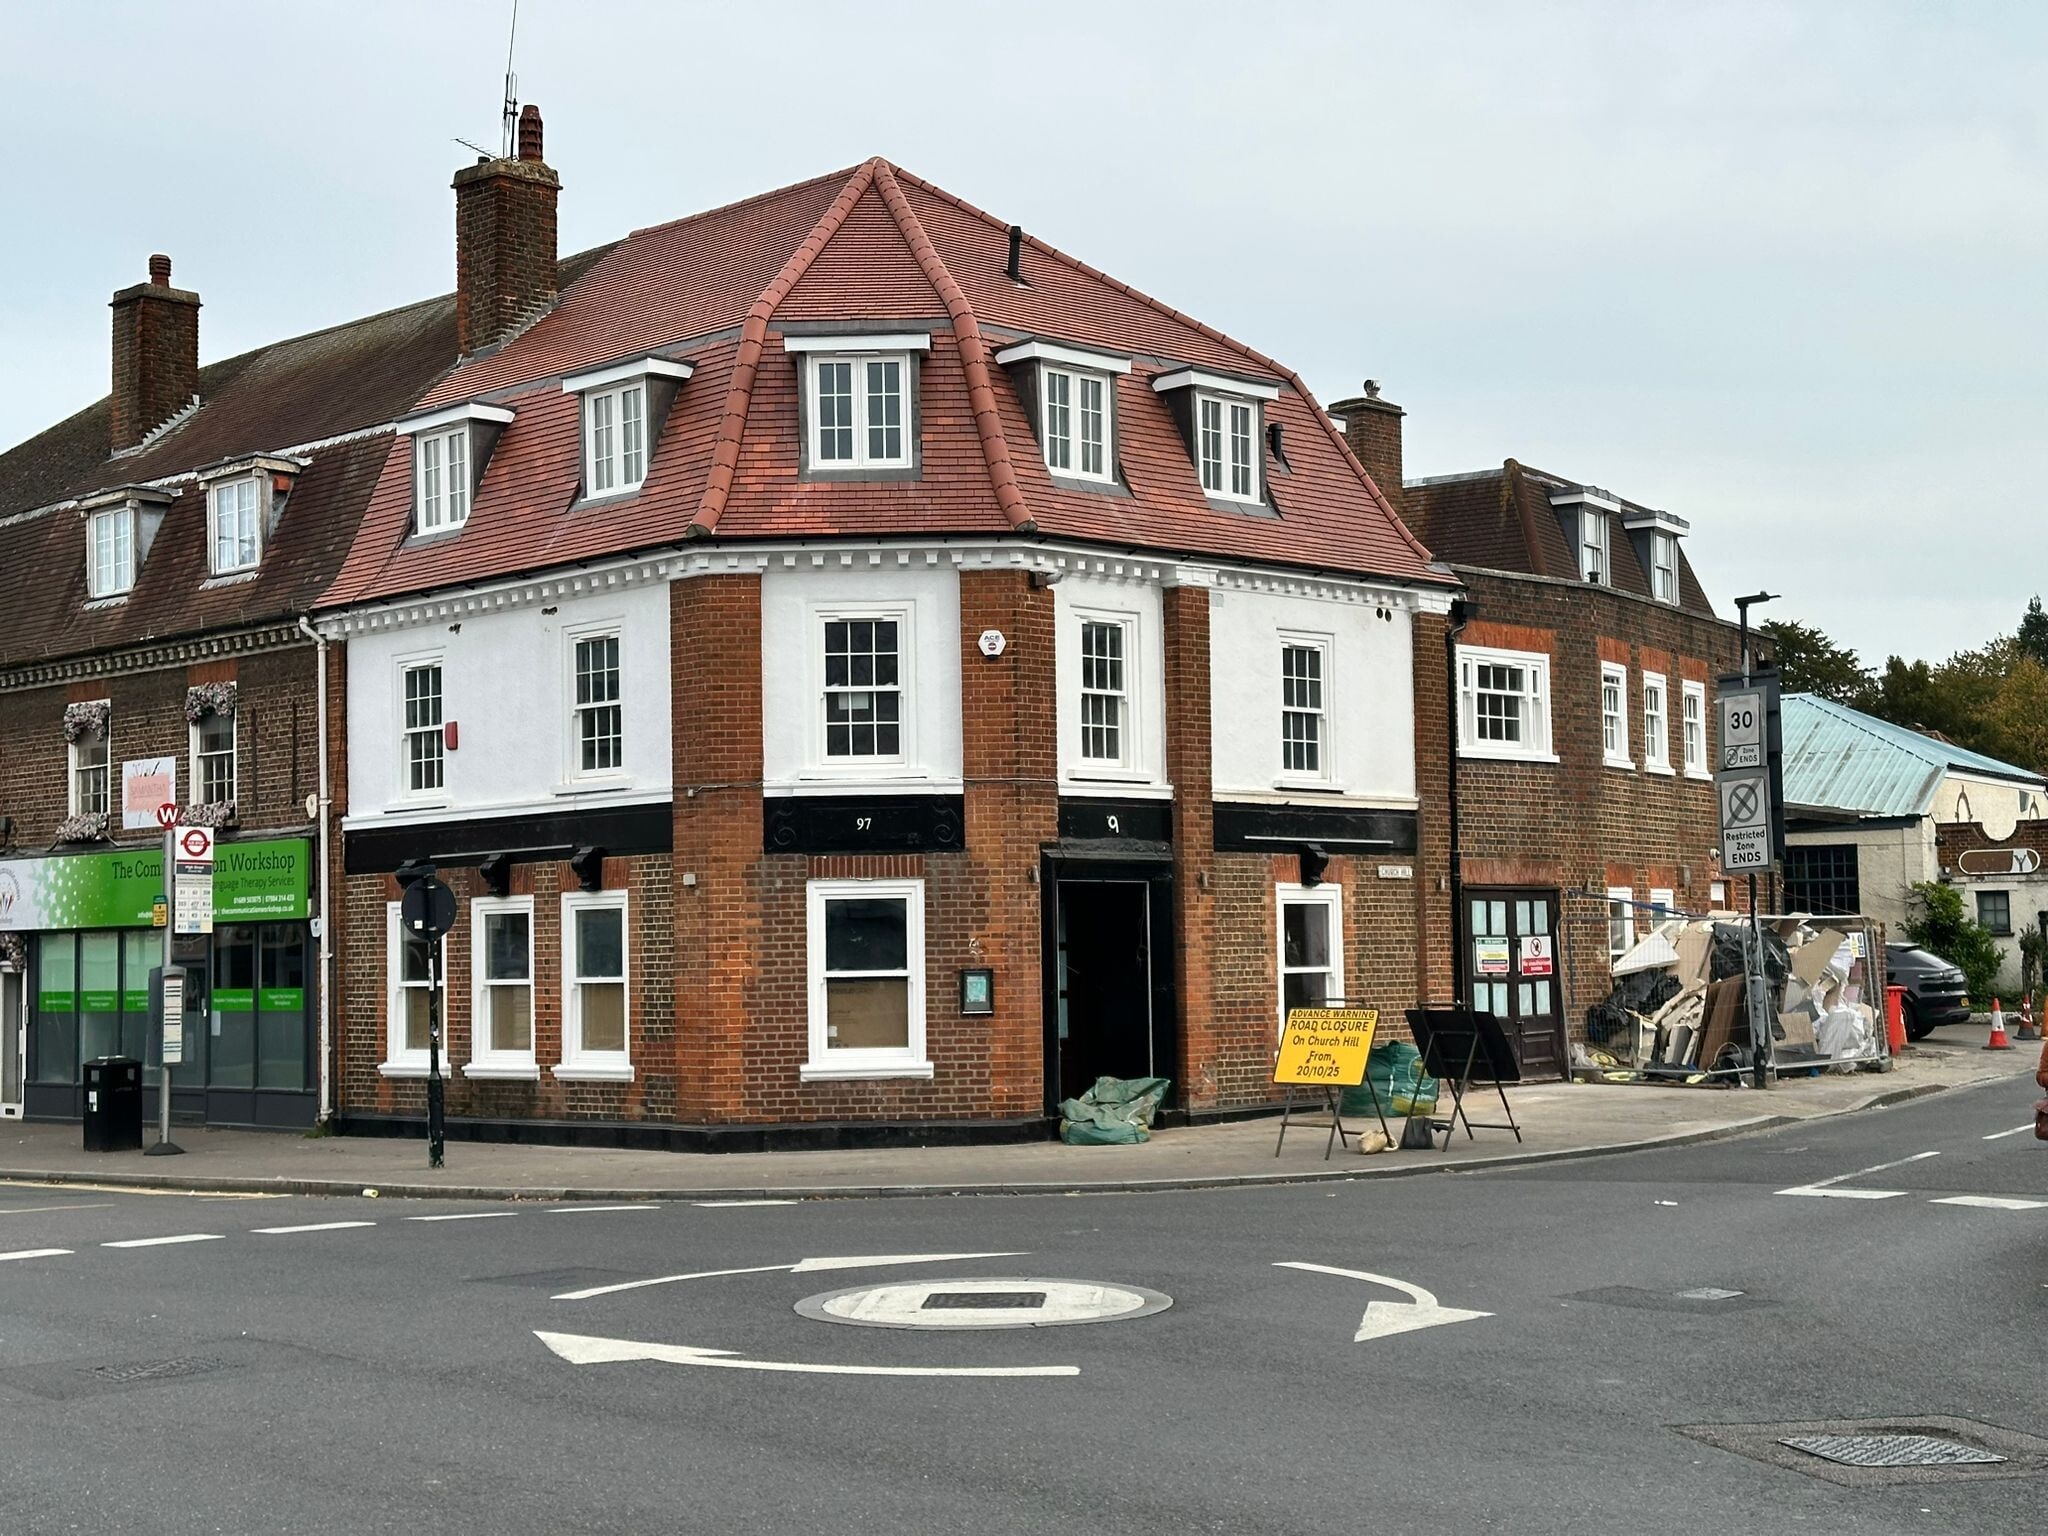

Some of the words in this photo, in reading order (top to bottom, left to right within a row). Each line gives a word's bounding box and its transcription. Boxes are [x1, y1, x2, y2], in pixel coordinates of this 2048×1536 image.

[1730, 710, 1753, 729] 30
[1739, 754, 1758, 763] ENDS
[159, 807, 179, 823] W
[856, 818, 872, 830] 97
[1107, 815, 1119, 833] 9
[1725, 829, 1765, 842] Restricted
[1736, 841, 1755, 851] Zone
[1732, 851, 1761, 864] ENDS
[112, 861, 133, 879] The
[135, 860, 162, 878] Com
[229, 850, 295, 874] Workshop
[241, 876, 266, 890] Therapy
[268, 875, 295, 888] Services
[1291, 1010, 1331, 1018] ADVANCE
[1333, 1011, 1375, 1019] WARNING
[1290, 1020, 1318, 1031] ROAD
[1321, 1021, 1369, 1032] CLOSURE
[1292, 1035, 1305, 1045] On
[1308, 1035, 1340, 1047] Church
[1342, 1036, 1360, 1047] Hill
[1309, 1051, 1332, 1061] From
[1296, 1065, 1340, 1078] 20/10/25
